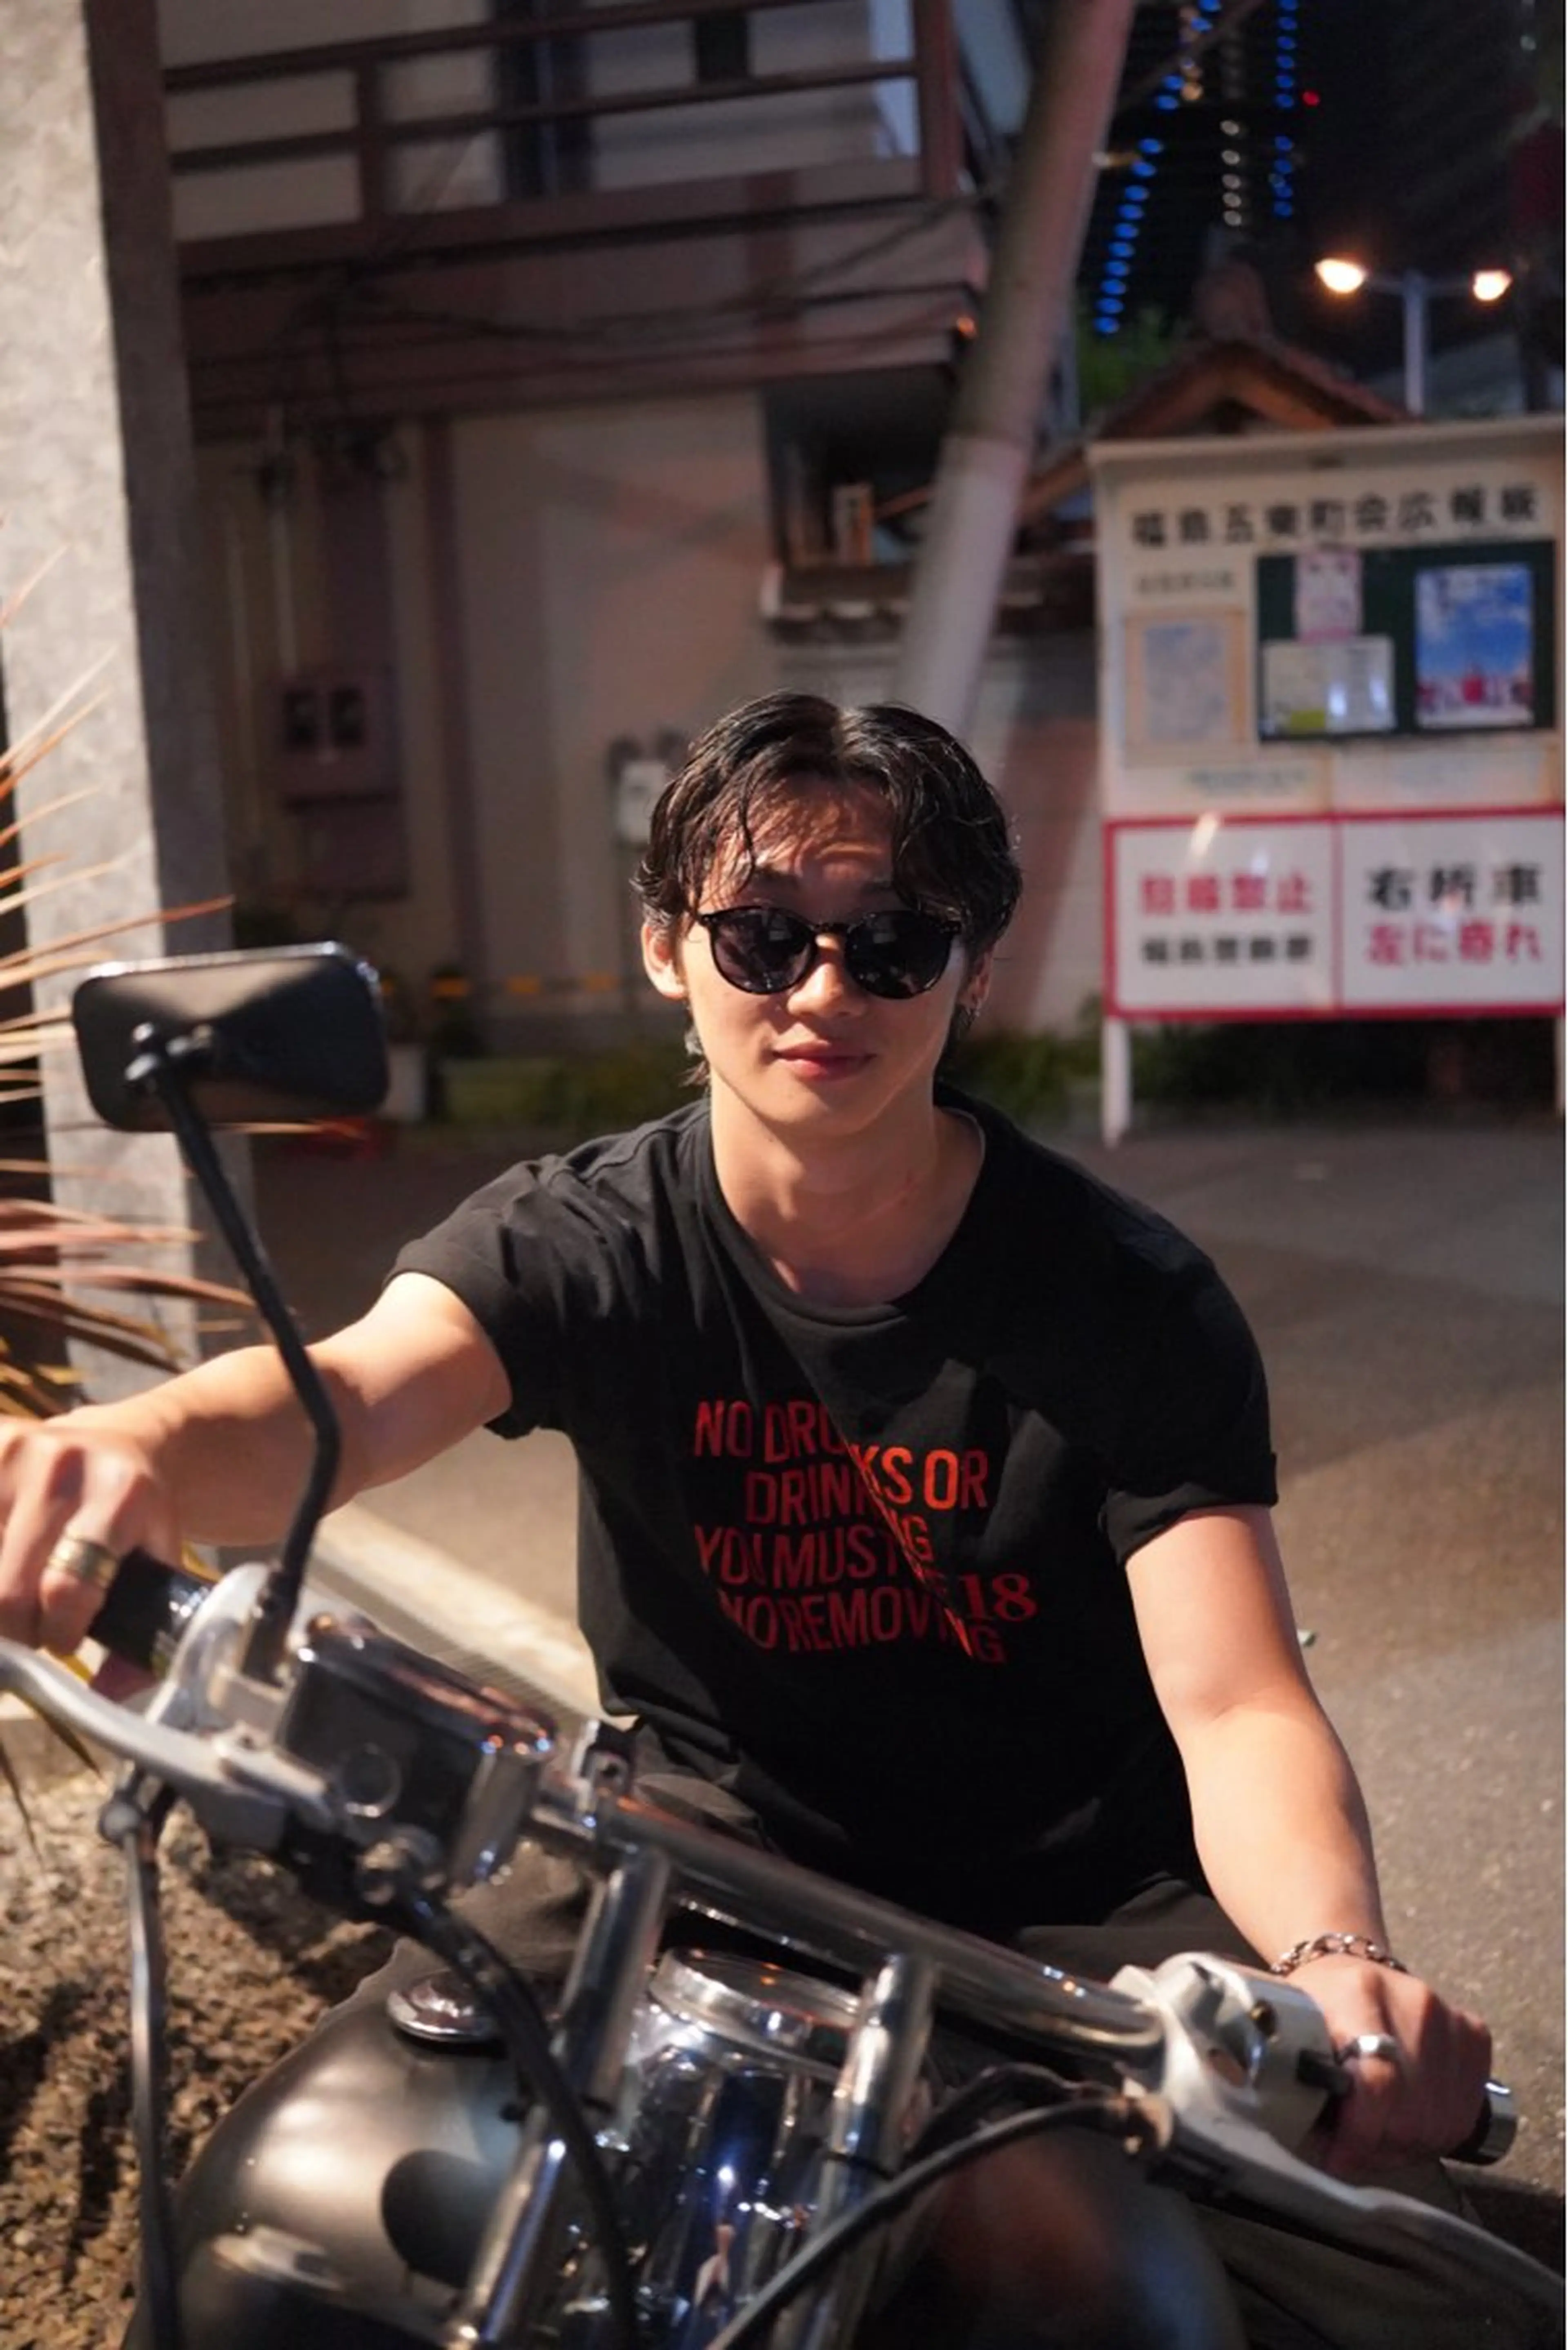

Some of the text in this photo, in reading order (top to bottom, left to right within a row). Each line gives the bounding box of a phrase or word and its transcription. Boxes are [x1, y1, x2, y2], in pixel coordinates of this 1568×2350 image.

[694, 1400, 753, 1457] NO
[924, 1448, 988, 1510] OR
[772, 1523, 898, 1589] MUST
[958, 1572, 1038, 1622] 18
